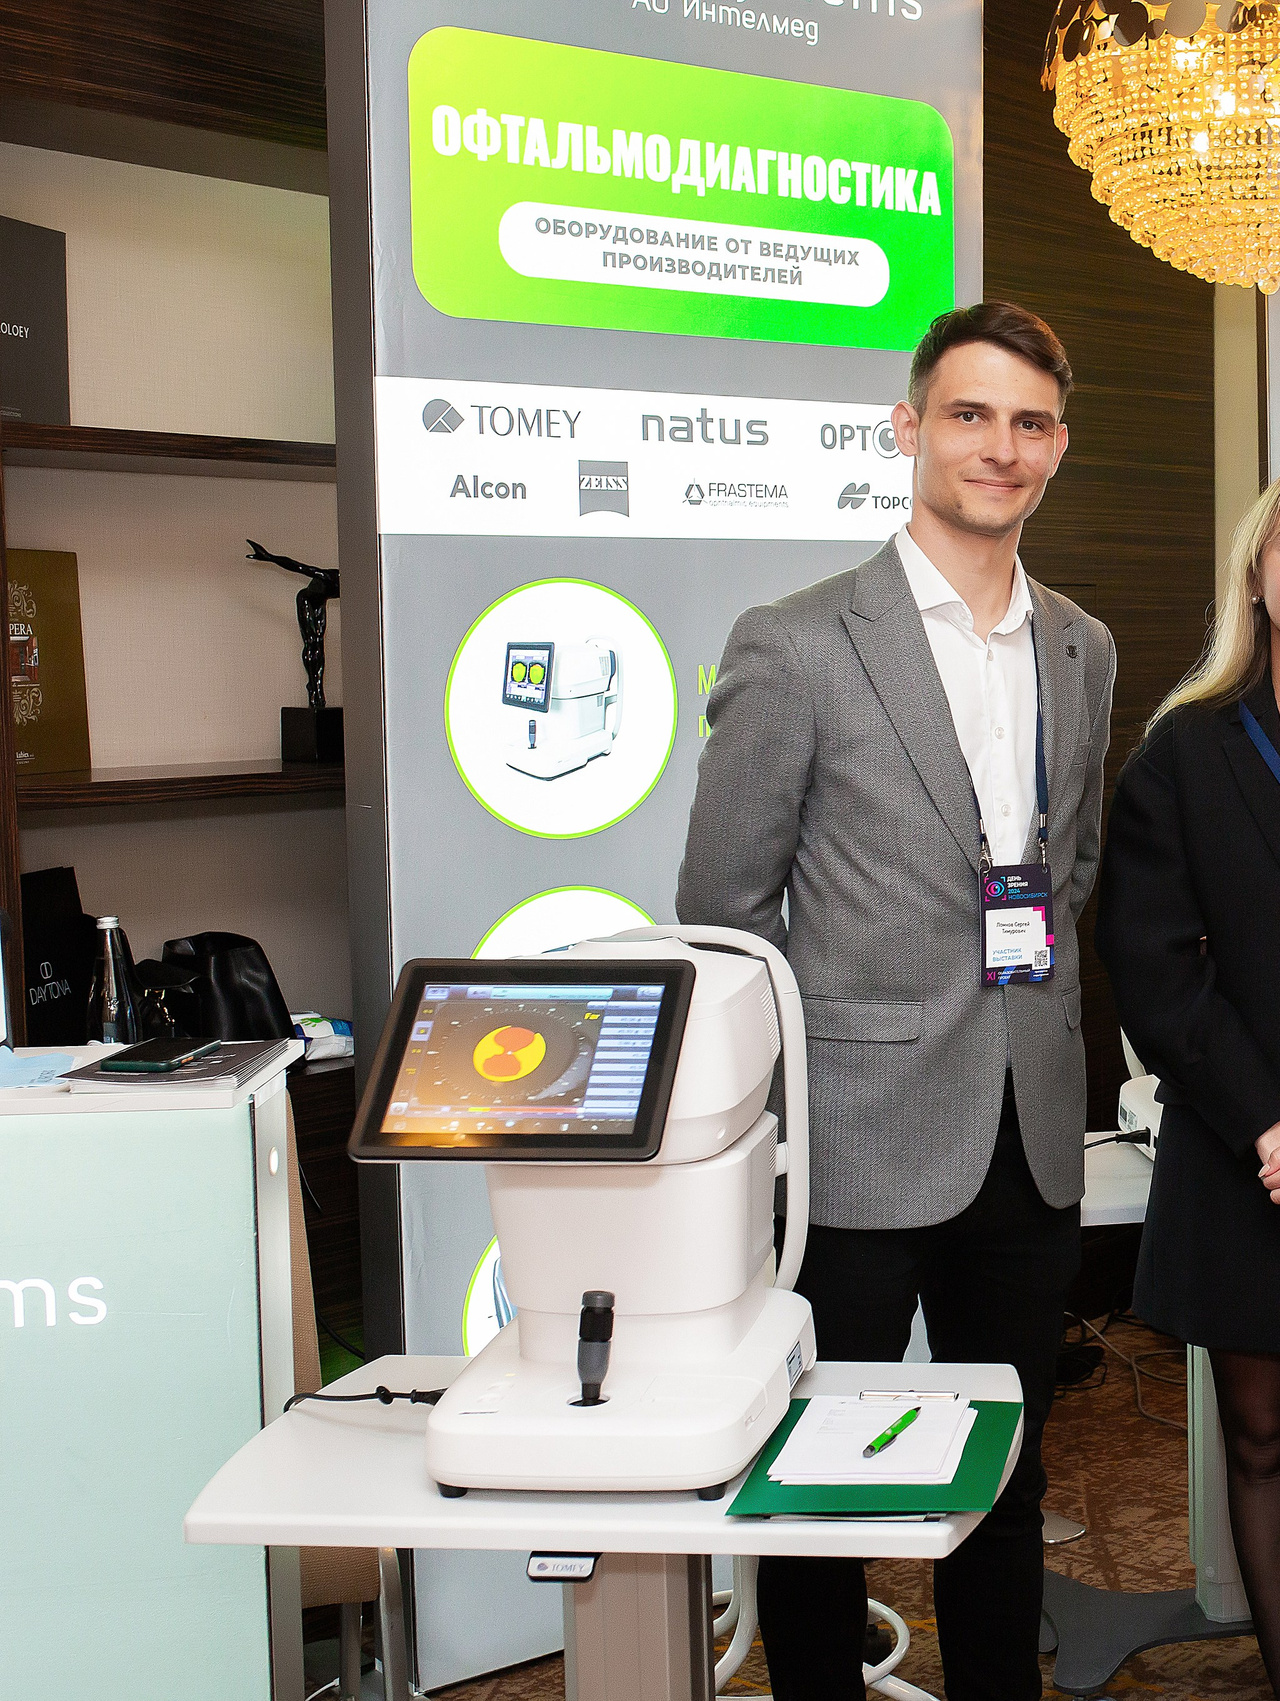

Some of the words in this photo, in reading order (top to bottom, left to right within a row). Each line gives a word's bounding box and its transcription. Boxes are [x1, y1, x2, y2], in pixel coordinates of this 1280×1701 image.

[432, 105, 942, 216] ОФТАЛЬМОДИАГНОСТИКА
[535, 217, 718, 252] ОБОРУДОВАНИЕ
[725, 237, 752, 255] ОТ
[759, 240, 860, 266] ВЕДУЩИХ
[602, 250, 803, 285] ПРОИЗВОДИТЕЛЕЙ
[470, 404, 582, 438] TOMEY
[642, 408, 769, 446] natus
[450, 474, 527, 500] Alcon
[579, 475, 629, 491] ZEISS
[708, 482, 789, 499] FRASTEMA
[872, 495, 912, 510] TOPC
[29, 979, 72, 1006] DAYTONA
